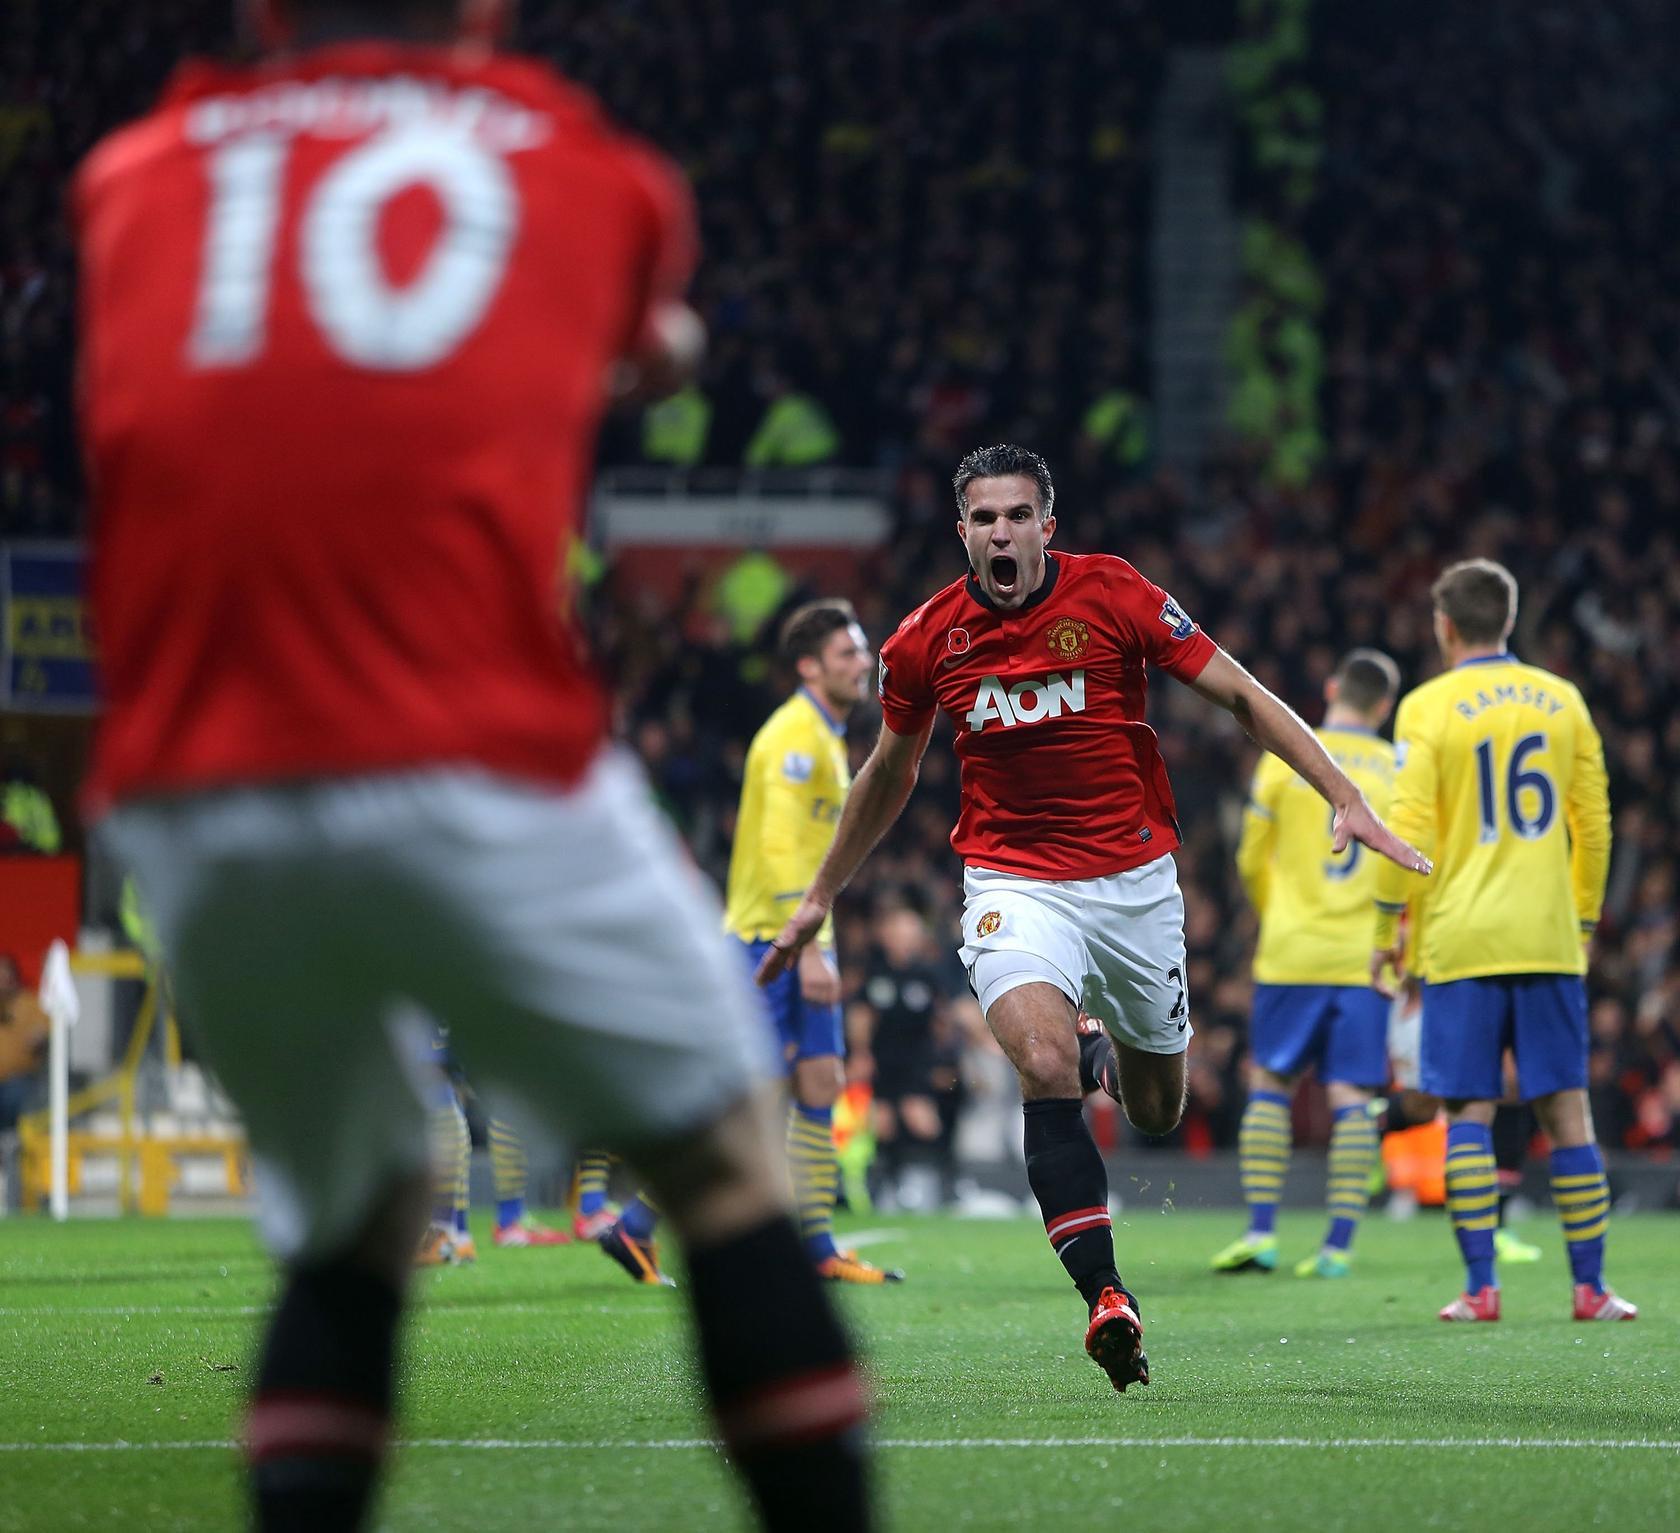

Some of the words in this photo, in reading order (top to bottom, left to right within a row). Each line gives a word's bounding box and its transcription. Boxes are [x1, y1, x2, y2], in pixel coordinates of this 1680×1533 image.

[186, 120, 523, 373] 10
[966, 669, 1085, 731] AON
[1457, 685, 1564, 721] RAMSEY
[1475, 733, 1556, 843] 16
